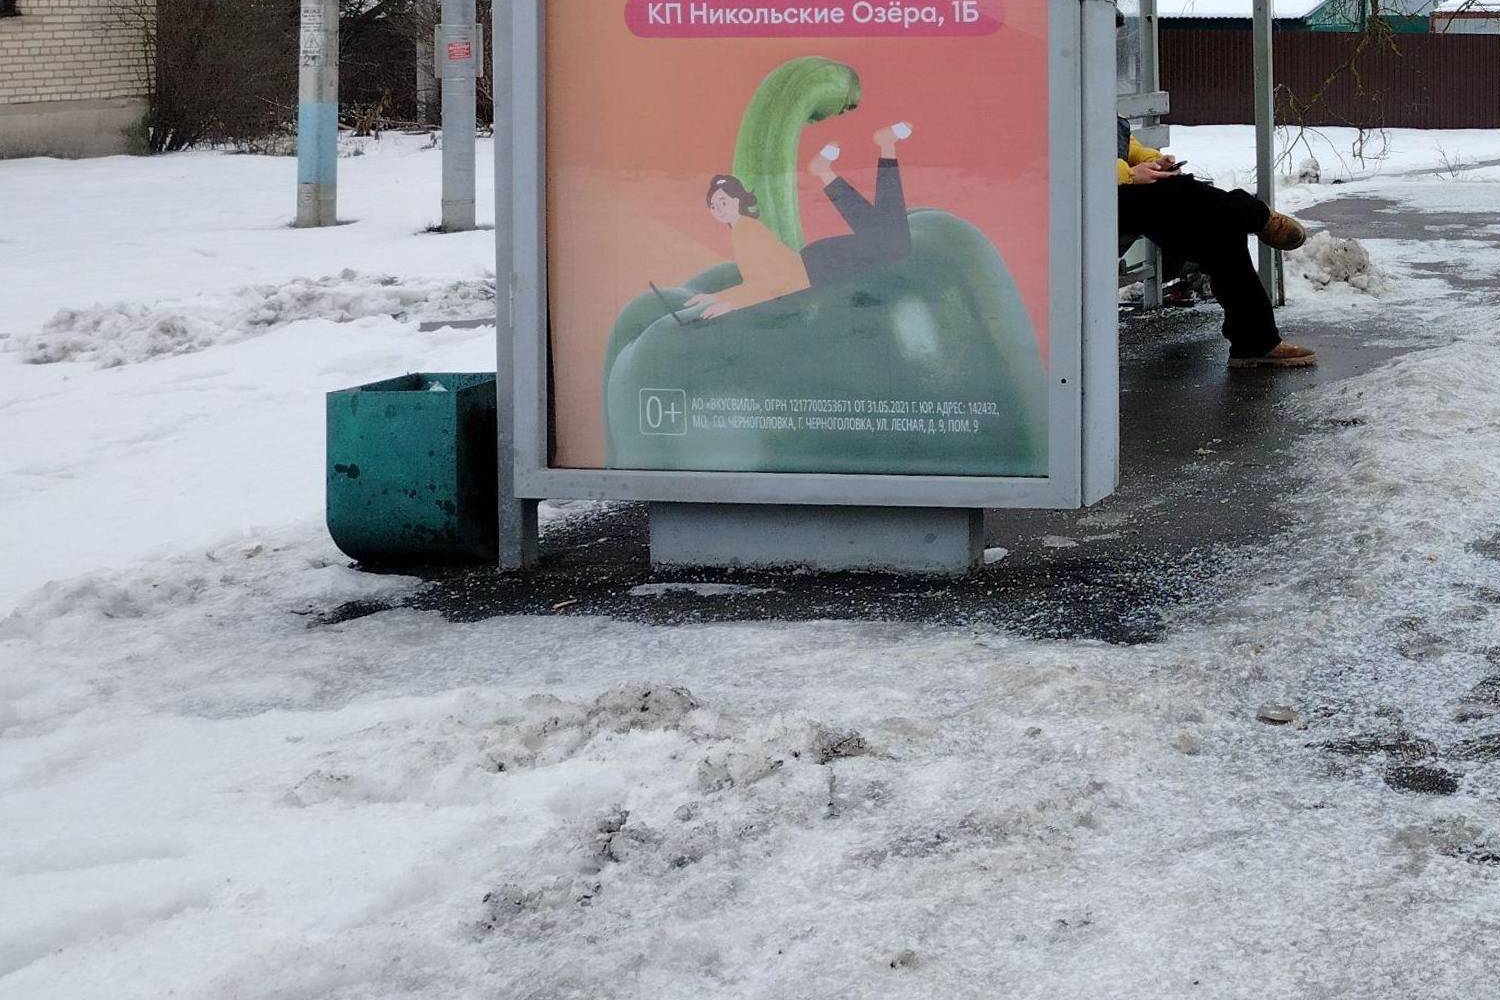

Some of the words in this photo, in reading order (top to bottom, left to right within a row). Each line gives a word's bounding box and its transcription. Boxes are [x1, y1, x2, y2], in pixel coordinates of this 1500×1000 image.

[648, 2, 682, 25] КП
[690, 1, 845, 25] Никольские
[852, 0, 944, 29] Озёра,
[951, 0, 980, 23] 1Б
[646, 396, 682, 428] 0+
[691, 397, 704, 410] АО
[764, 399, 787, 412] ОГРН
[854, 400, 866, 412] ОТ
[867, 400, 909, 415] 31.05.2021
[919, 402, 935, 414] ЮР.
[936, 402, 966, 417] АДРЕС:
[968, 402, 1000, 416] 142432,
[806, 417, 875, 432] ЧЕРНОГОЛОВКА,
[876, 418, 889, 431] УЛ.
[891, 418, 927, 433] ЛЕСНАЯ,
[928, 419, 937, 434] Д.
[948, 419, 971, 432] ПОМ.
